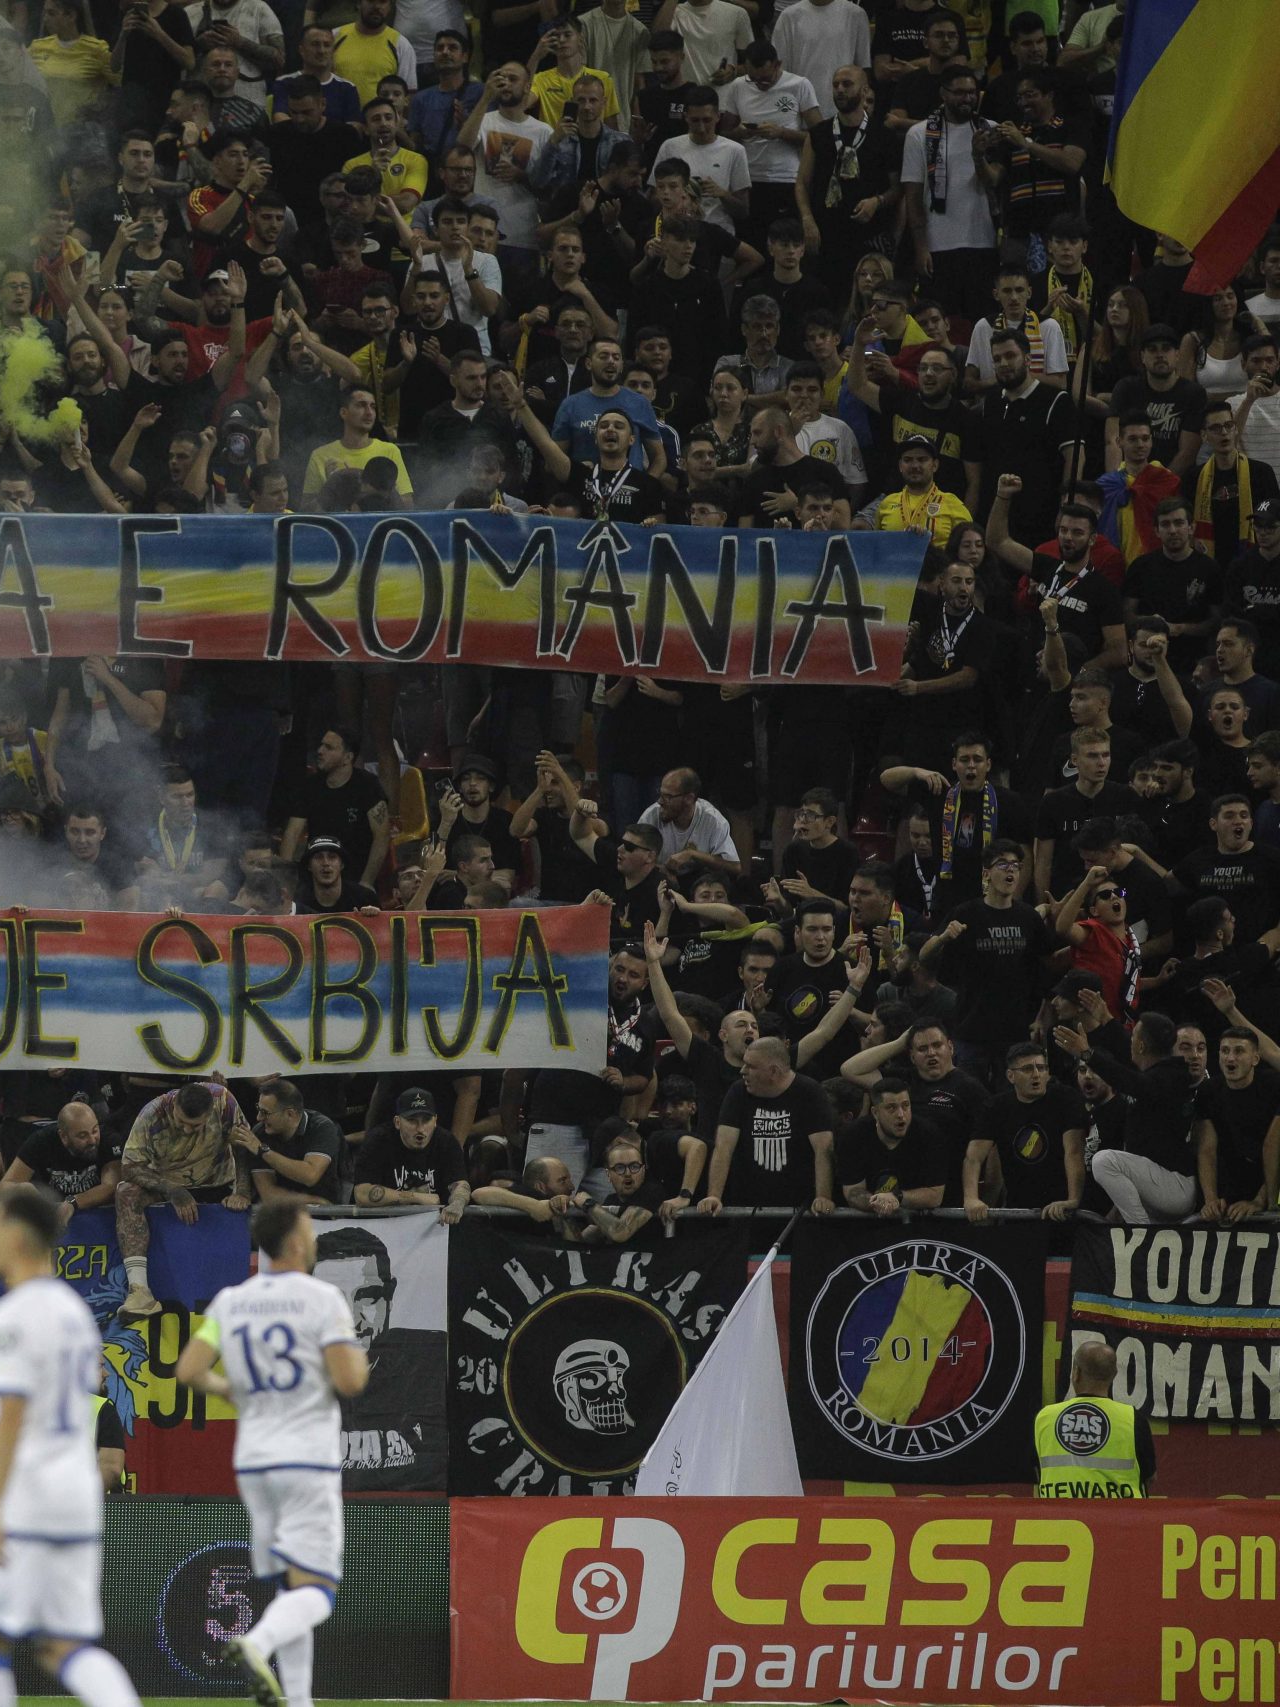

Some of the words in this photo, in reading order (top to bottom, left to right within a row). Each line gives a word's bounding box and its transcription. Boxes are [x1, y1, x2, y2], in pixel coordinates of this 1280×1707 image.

[118, 514, 194, 658] E
[988, 926, 1022, 939] YOUTH
[136, 912, 573, 1070] SRBIJA
[1110, 1227, 1280, 1306] YOUT
[231, 1322, 305, 1395] 13
[825, 1386, 997, 1456] ROMANIA
[1060, 1413, 1103, 1435] SAS
[1060, 1432, 1102, 1446] TEAM
[712, 1518, 1095, 1627] casa
[1161, 1523, 1280, 1601] Pen
[704, 1632, 1079, 1701] pariurilor
[1161, 1626, 1280, 1704] Pen
